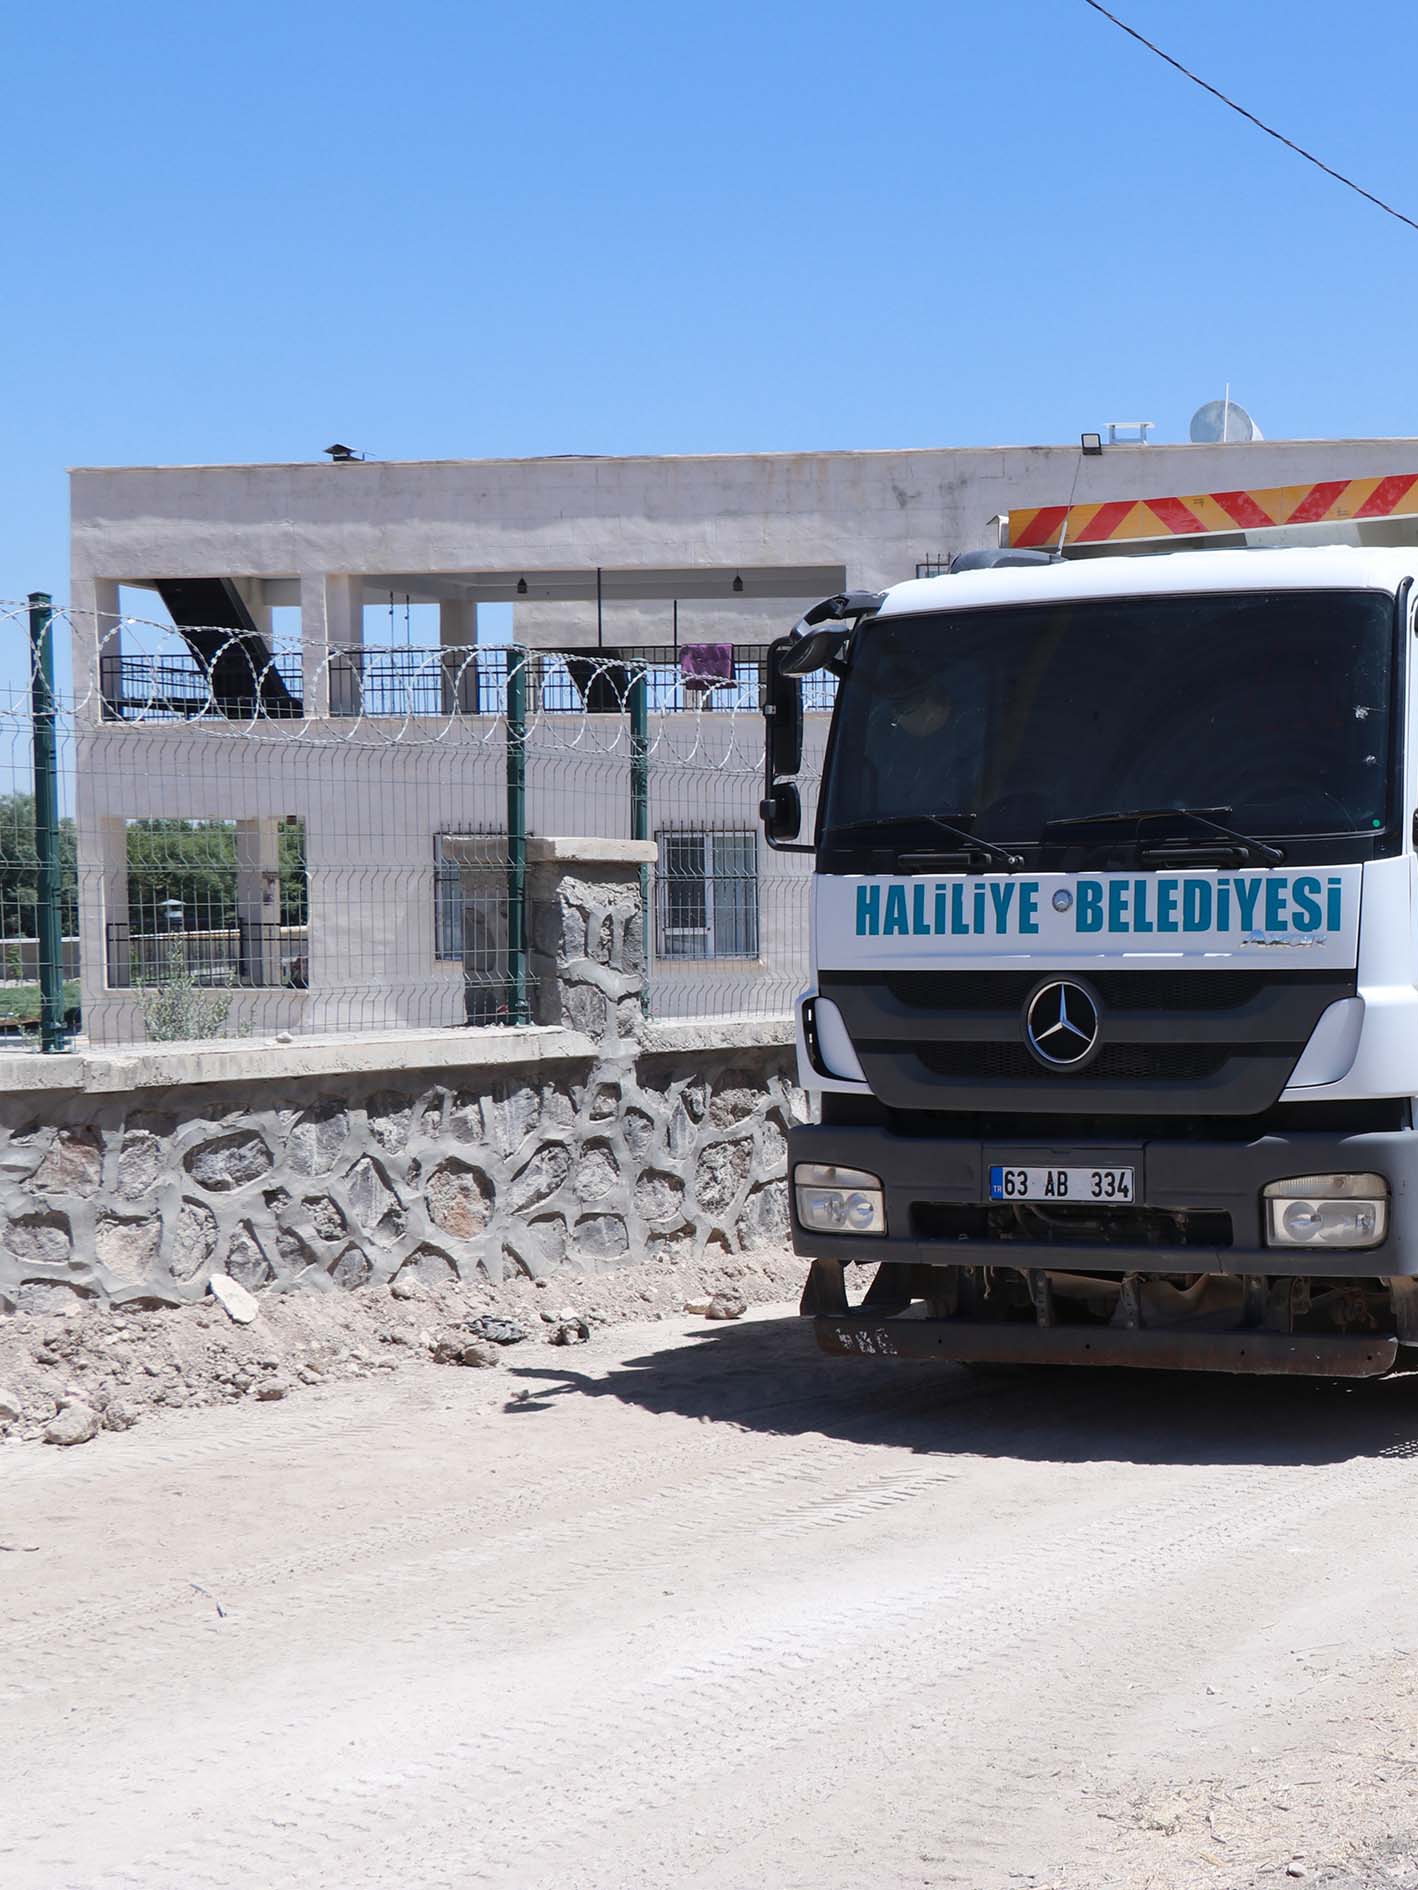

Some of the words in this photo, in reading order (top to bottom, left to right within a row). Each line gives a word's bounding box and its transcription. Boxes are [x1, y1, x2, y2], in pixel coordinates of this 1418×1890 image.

[1004, 1170, 1028, 1196] 63
[1044, 1170, 1068, 1197] AB
[1091, 1171, 1130, 1198] 334
